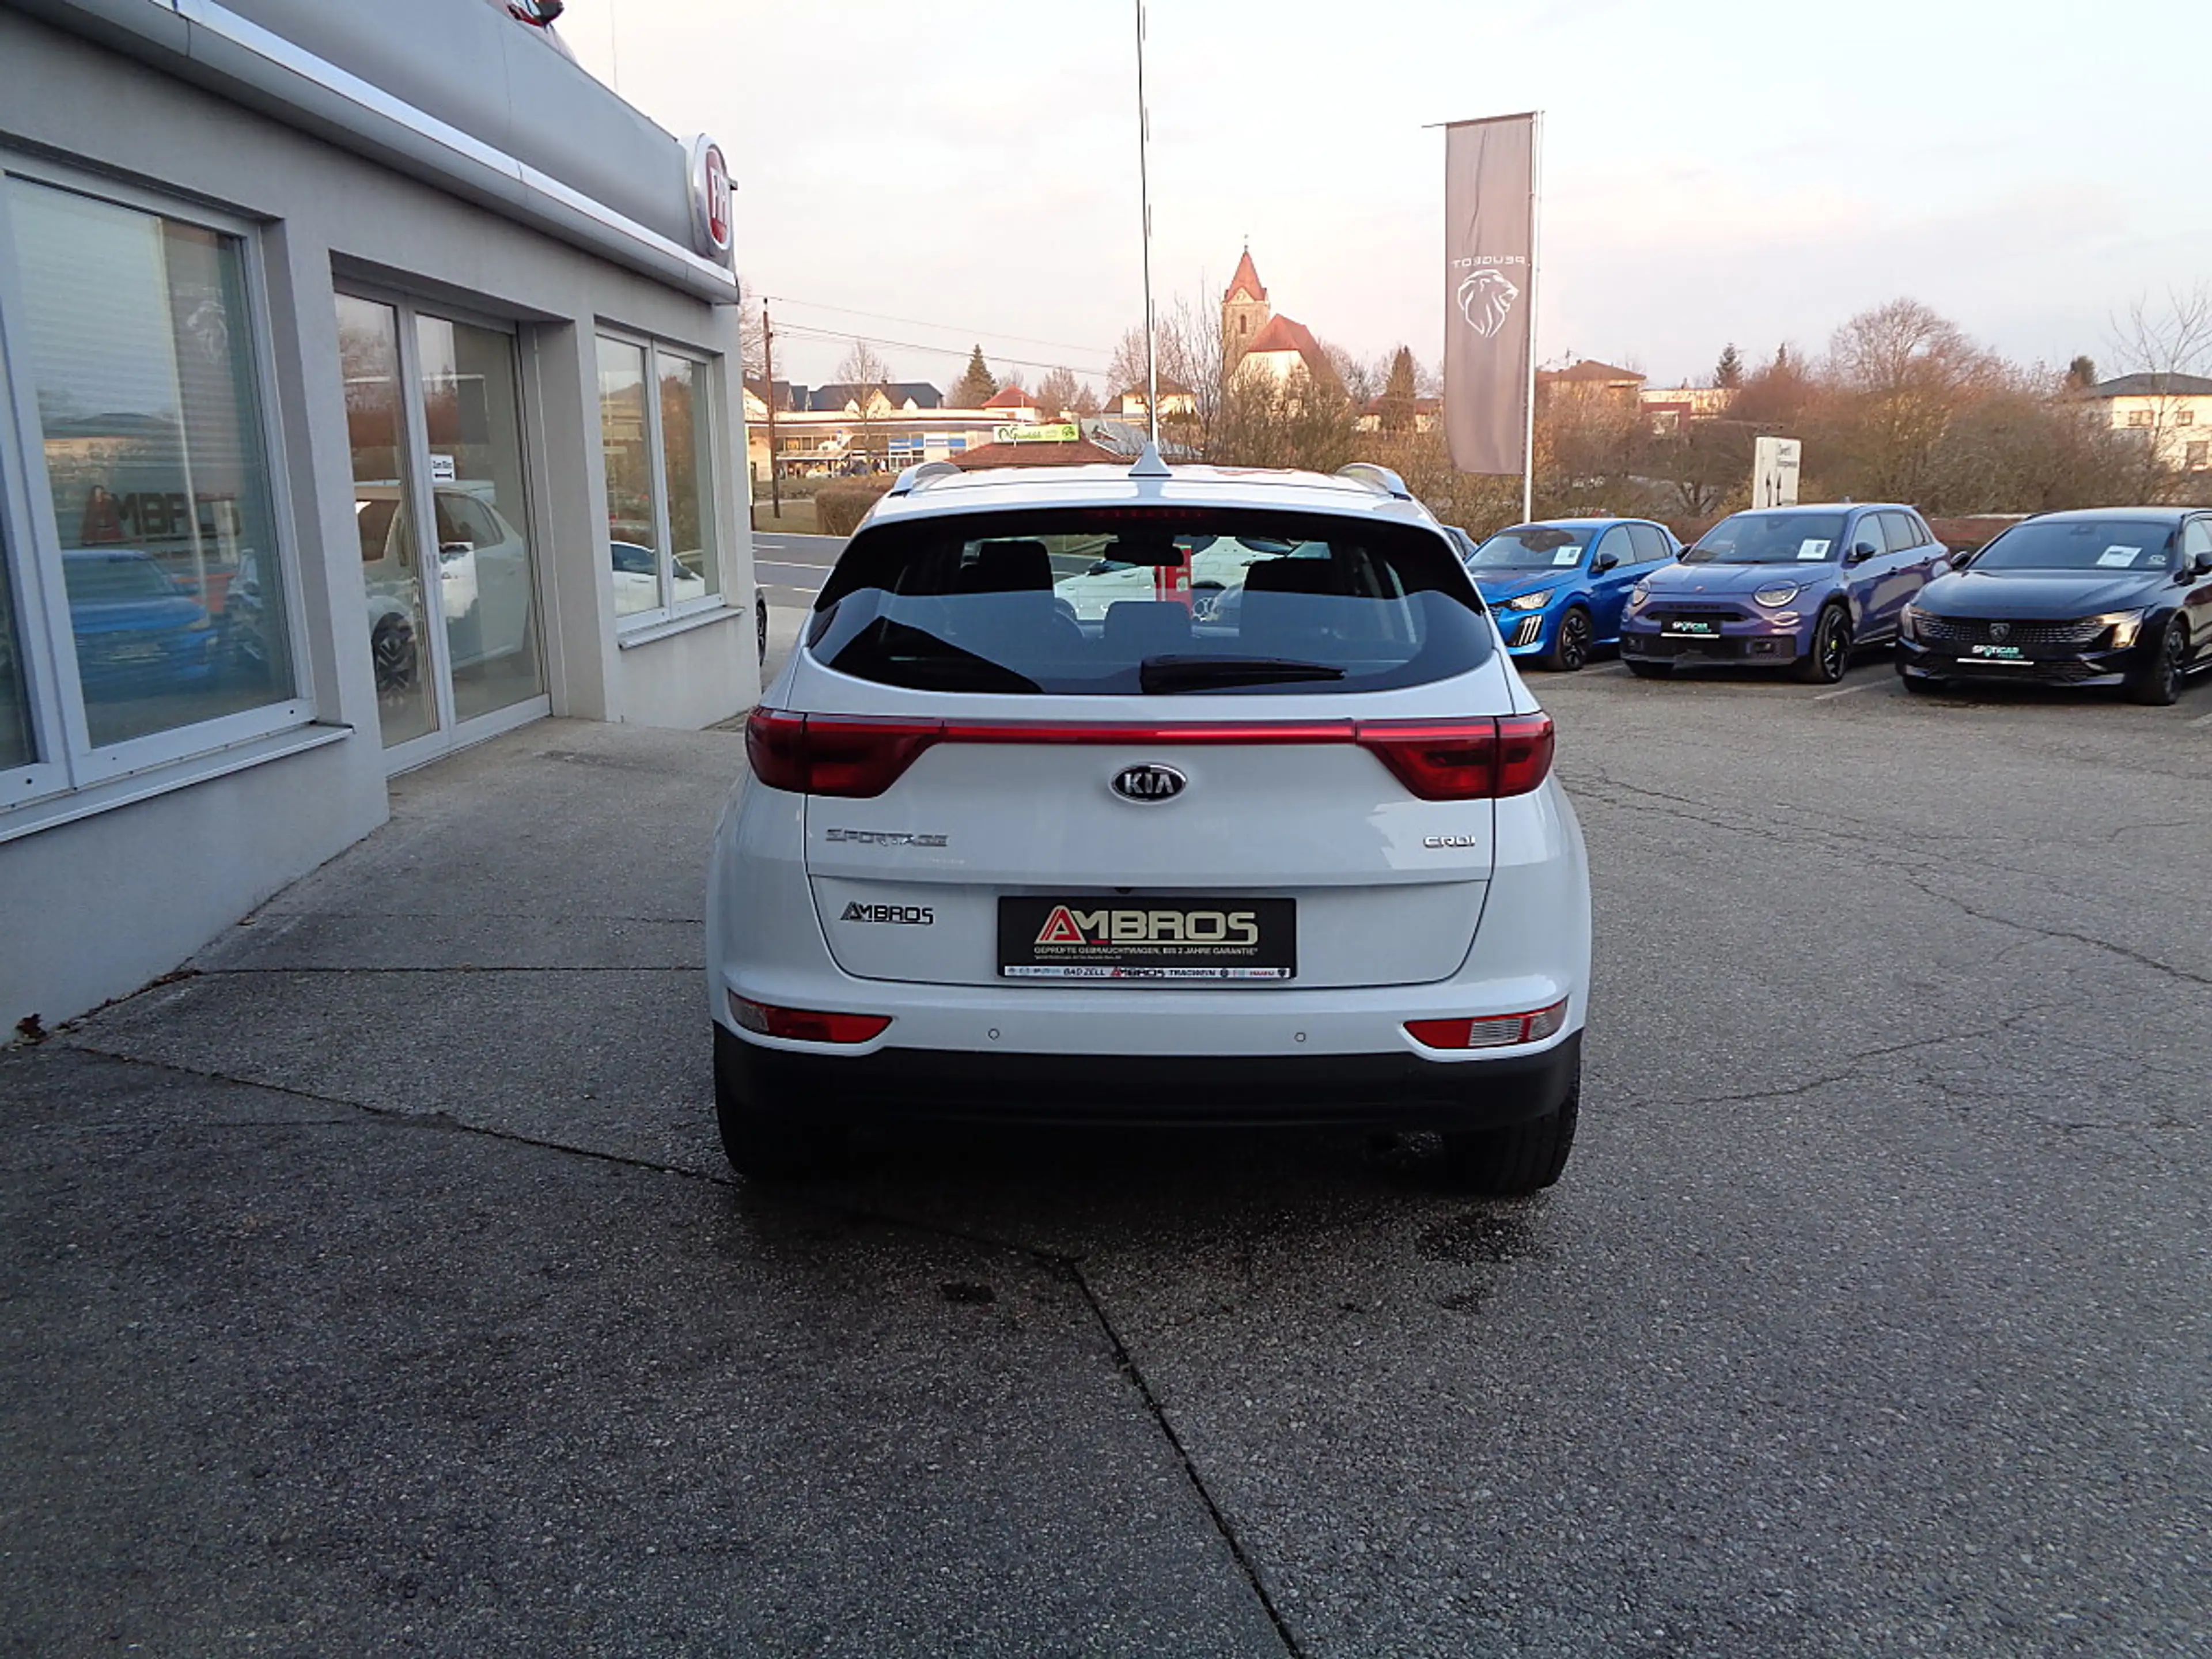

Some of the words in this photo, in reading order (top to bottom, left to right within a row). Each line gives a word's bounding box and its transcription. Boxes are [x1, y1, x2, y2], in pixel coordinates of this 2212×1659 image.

[1124, 772, 1175, 794] KIA
[840, 900, 934, 925] AMBROS
[1035, 905, 1259, 944] AMBROS
